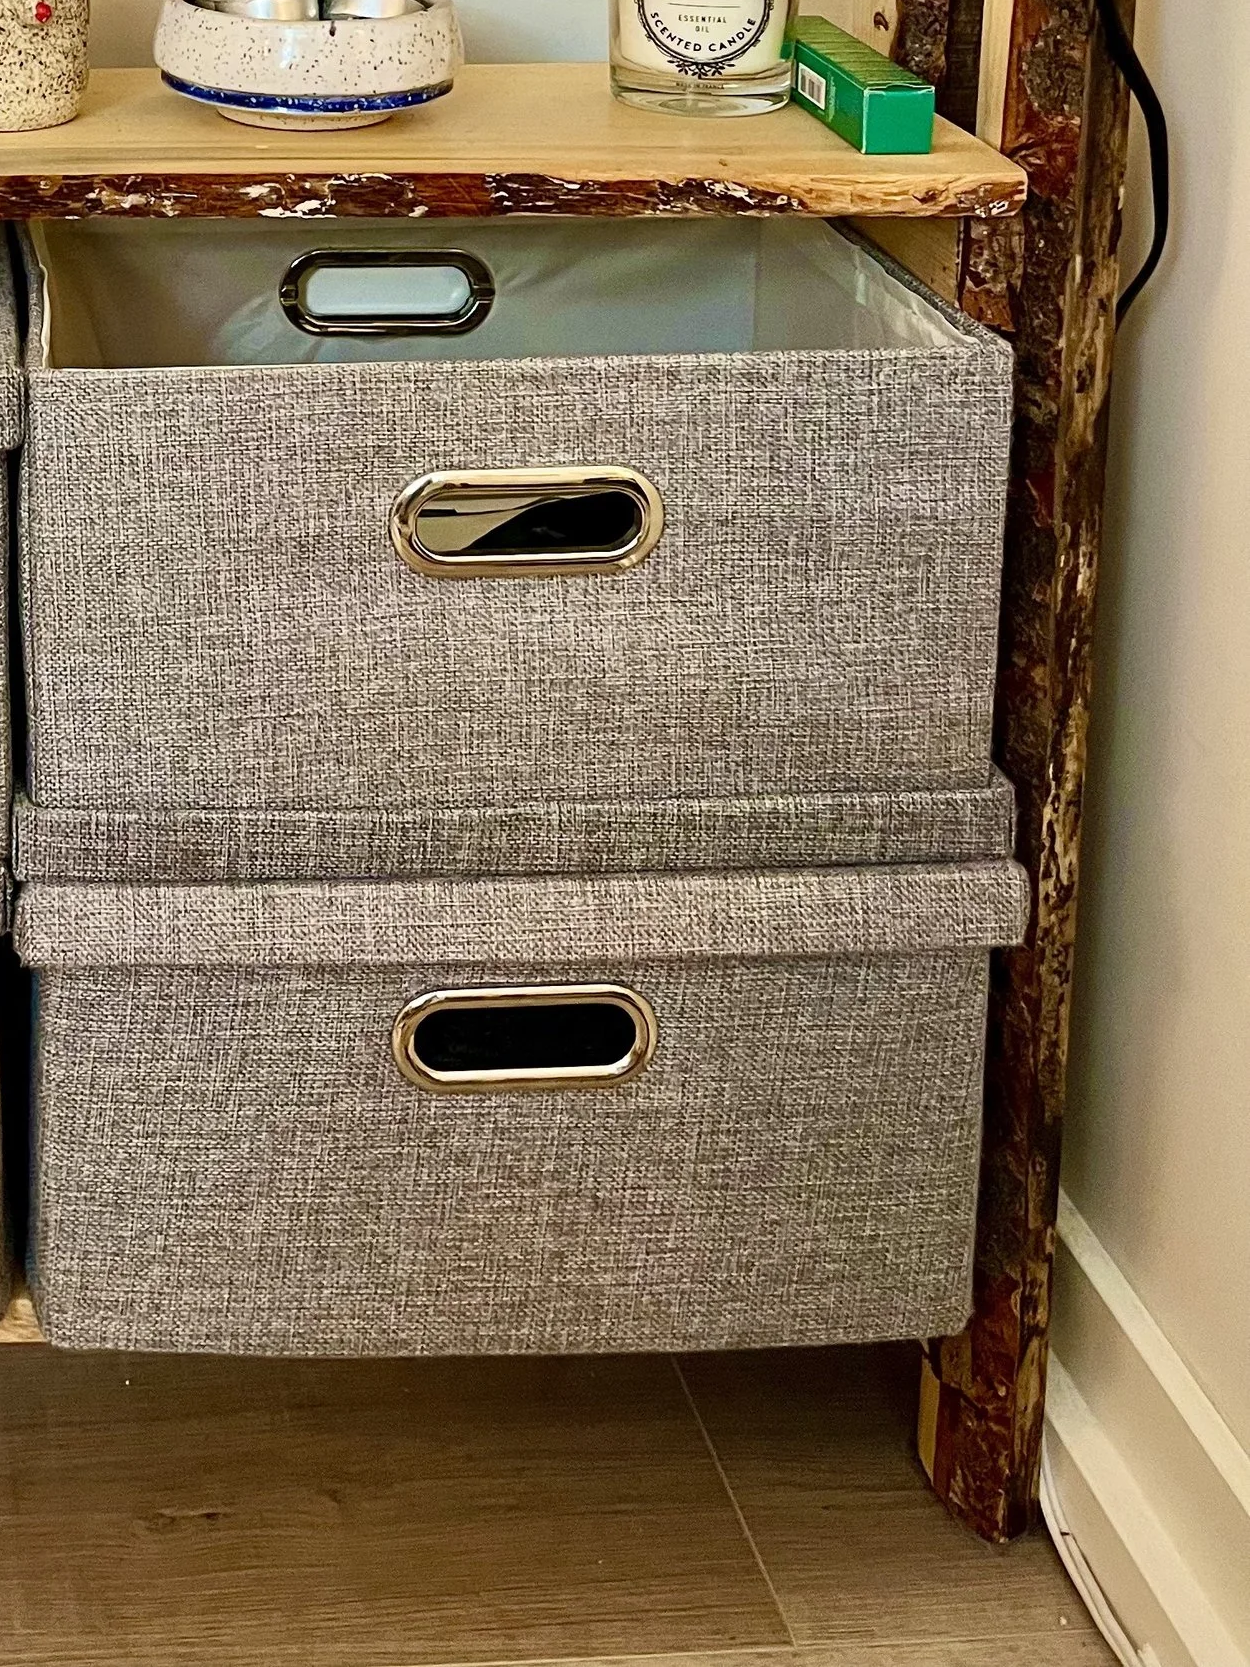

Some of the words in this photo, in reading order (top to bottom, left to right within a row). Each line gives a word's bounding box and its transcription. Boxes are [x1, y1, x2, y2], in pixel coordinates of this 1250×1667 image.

[678, 14, 727, 24] ESSENTIAL
[650, 12, 702, 52] SCENTED
[708, 18, 756, 52] CANDLE
